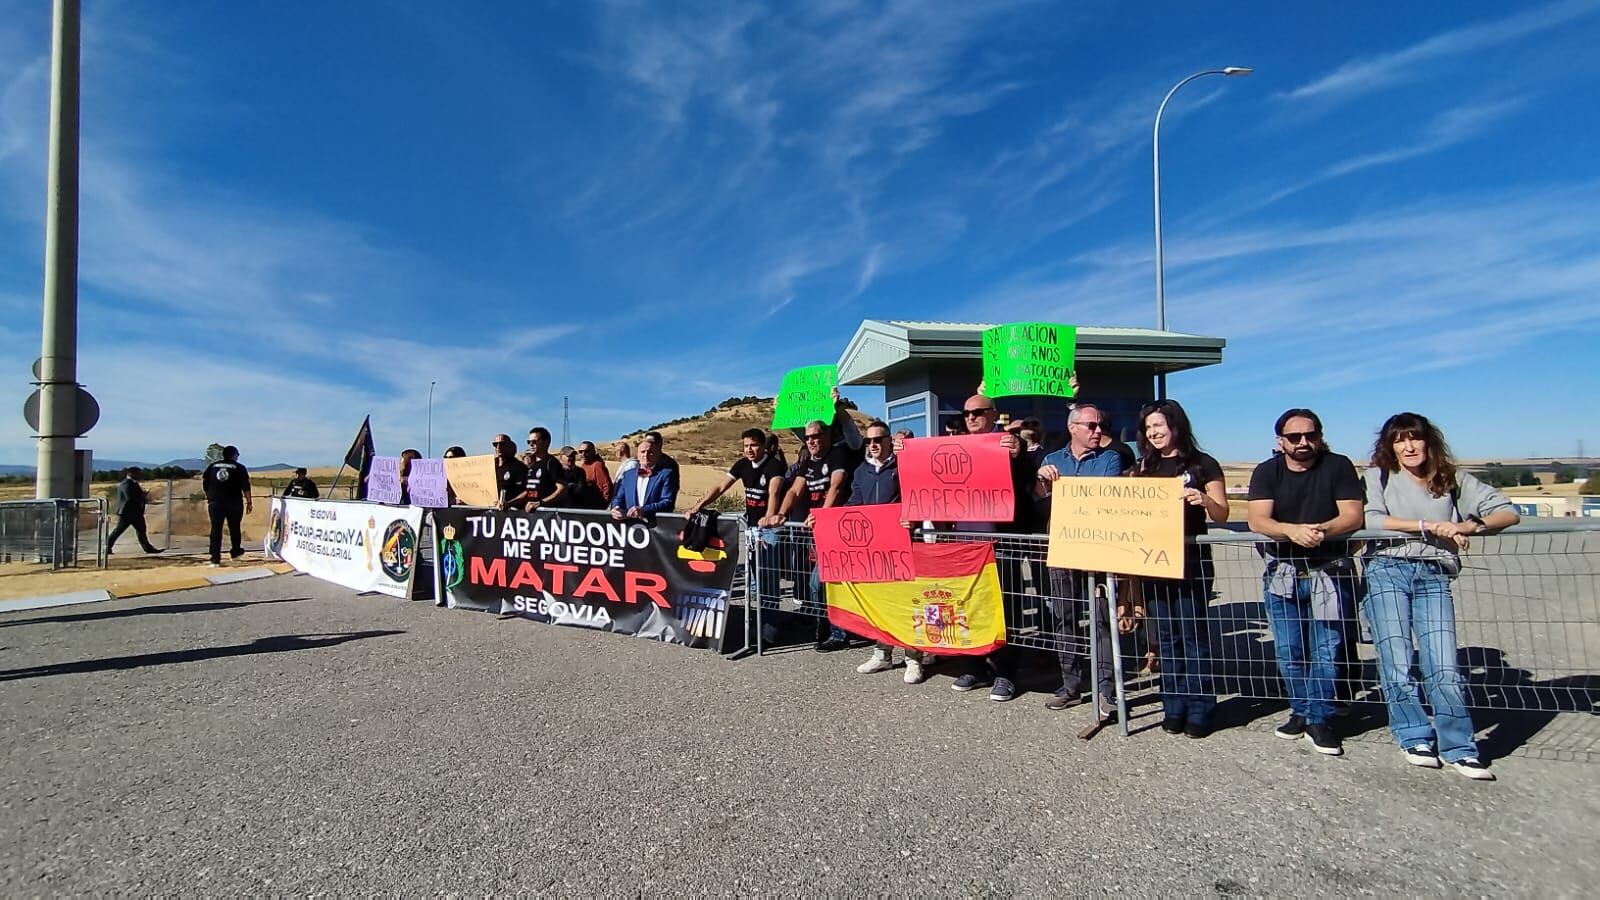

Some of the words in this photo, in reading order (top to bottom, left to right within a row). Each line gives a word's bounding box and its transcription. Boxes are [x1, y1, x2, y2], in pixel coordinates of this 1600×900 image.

[934, 452, 969, 476] STOP
[1062, 484, 1169, 500] FUNCIONARIOS
[466, 516, 495, 539] TU
[500, 517, 650, 550] ABANDONO
[843, 519, 870, 542] STOP
[1059, 526, 1144, 543] AUTORIDAD
[503, 540, 531, 559] ME
[540, 543, 625, 568] PUEDE
[1139, 547, 1170, 566] YA
[470, 556, 672, 608] MATAR
[513, 595, 611, 624] SEGOVIA
